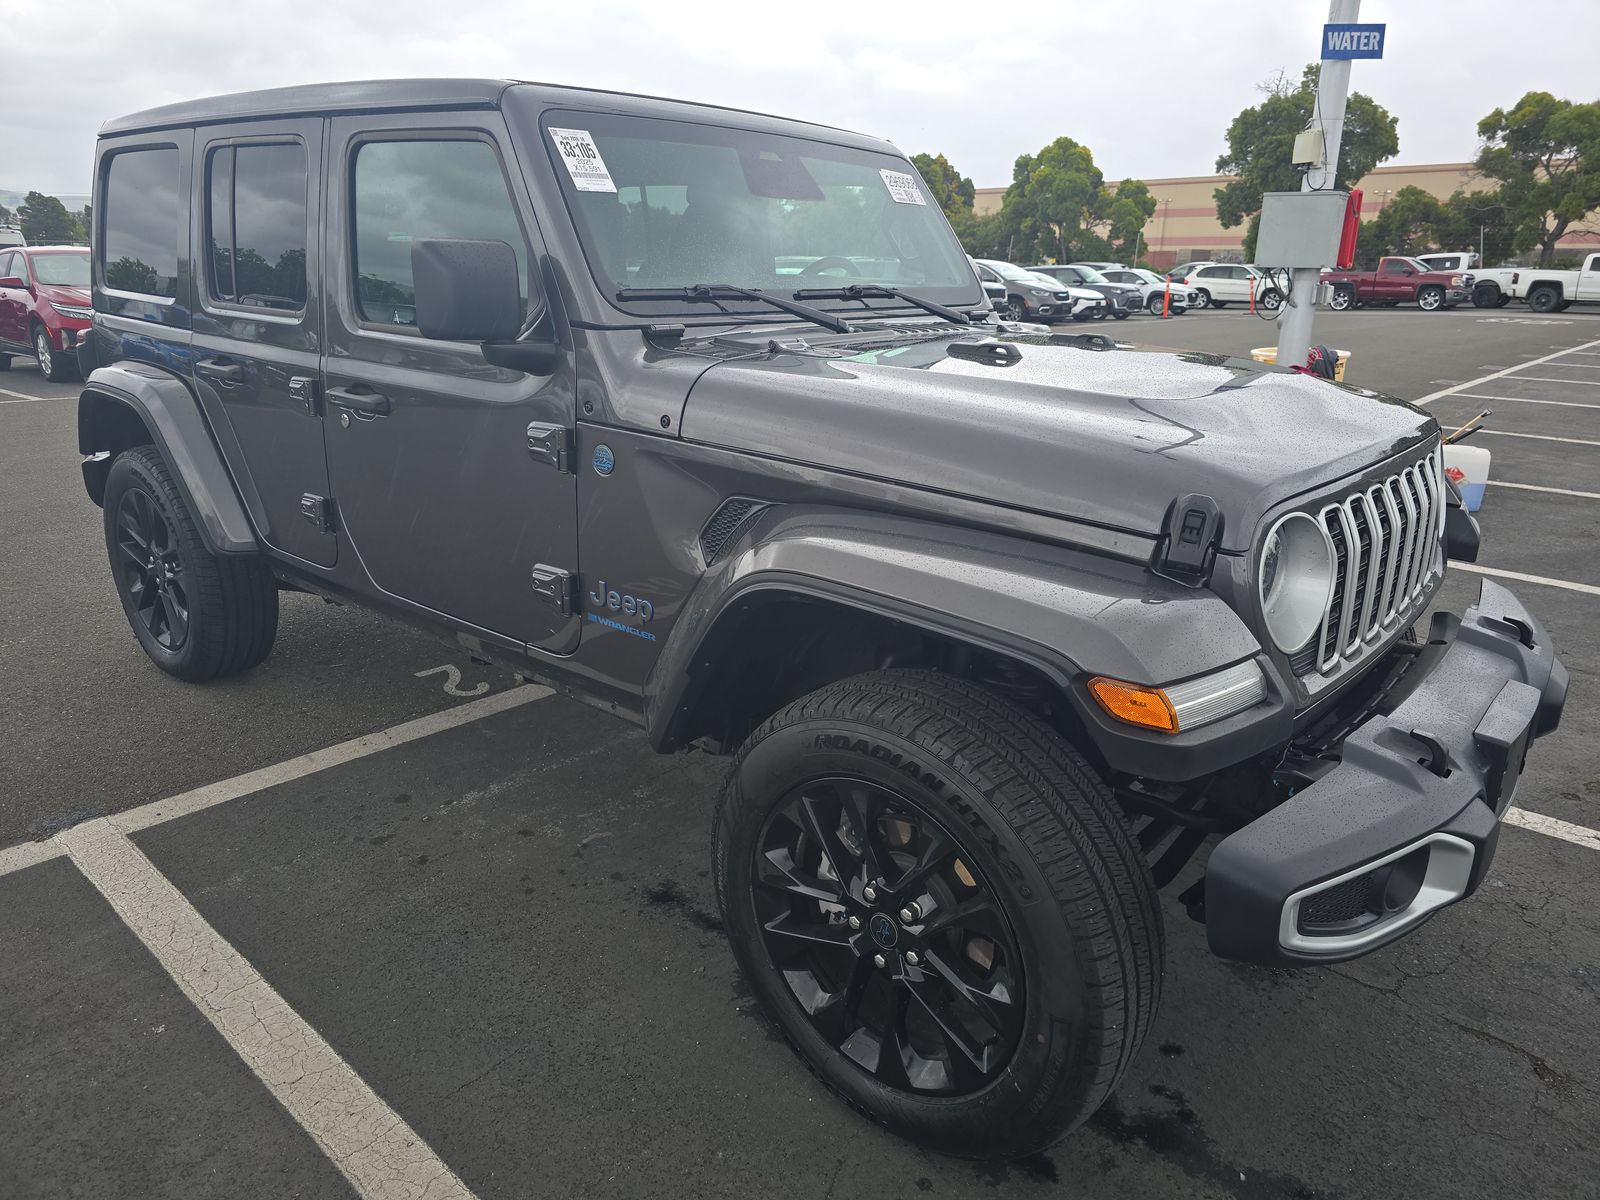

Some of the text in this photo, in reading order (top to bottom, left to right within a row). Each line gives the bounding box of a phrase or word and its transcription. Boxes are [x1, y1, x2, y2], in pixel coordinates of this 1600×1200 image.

[1328, 31, 1380, 51] WATER
[560, 140, 597, 159] 33:105
[576, 158, 594, 166] 2025
[589, 580, 654, 625] Jeep
[598, 616, 657, 642] WRANGLER
[814, 733, 946, 793] ROADIAN
